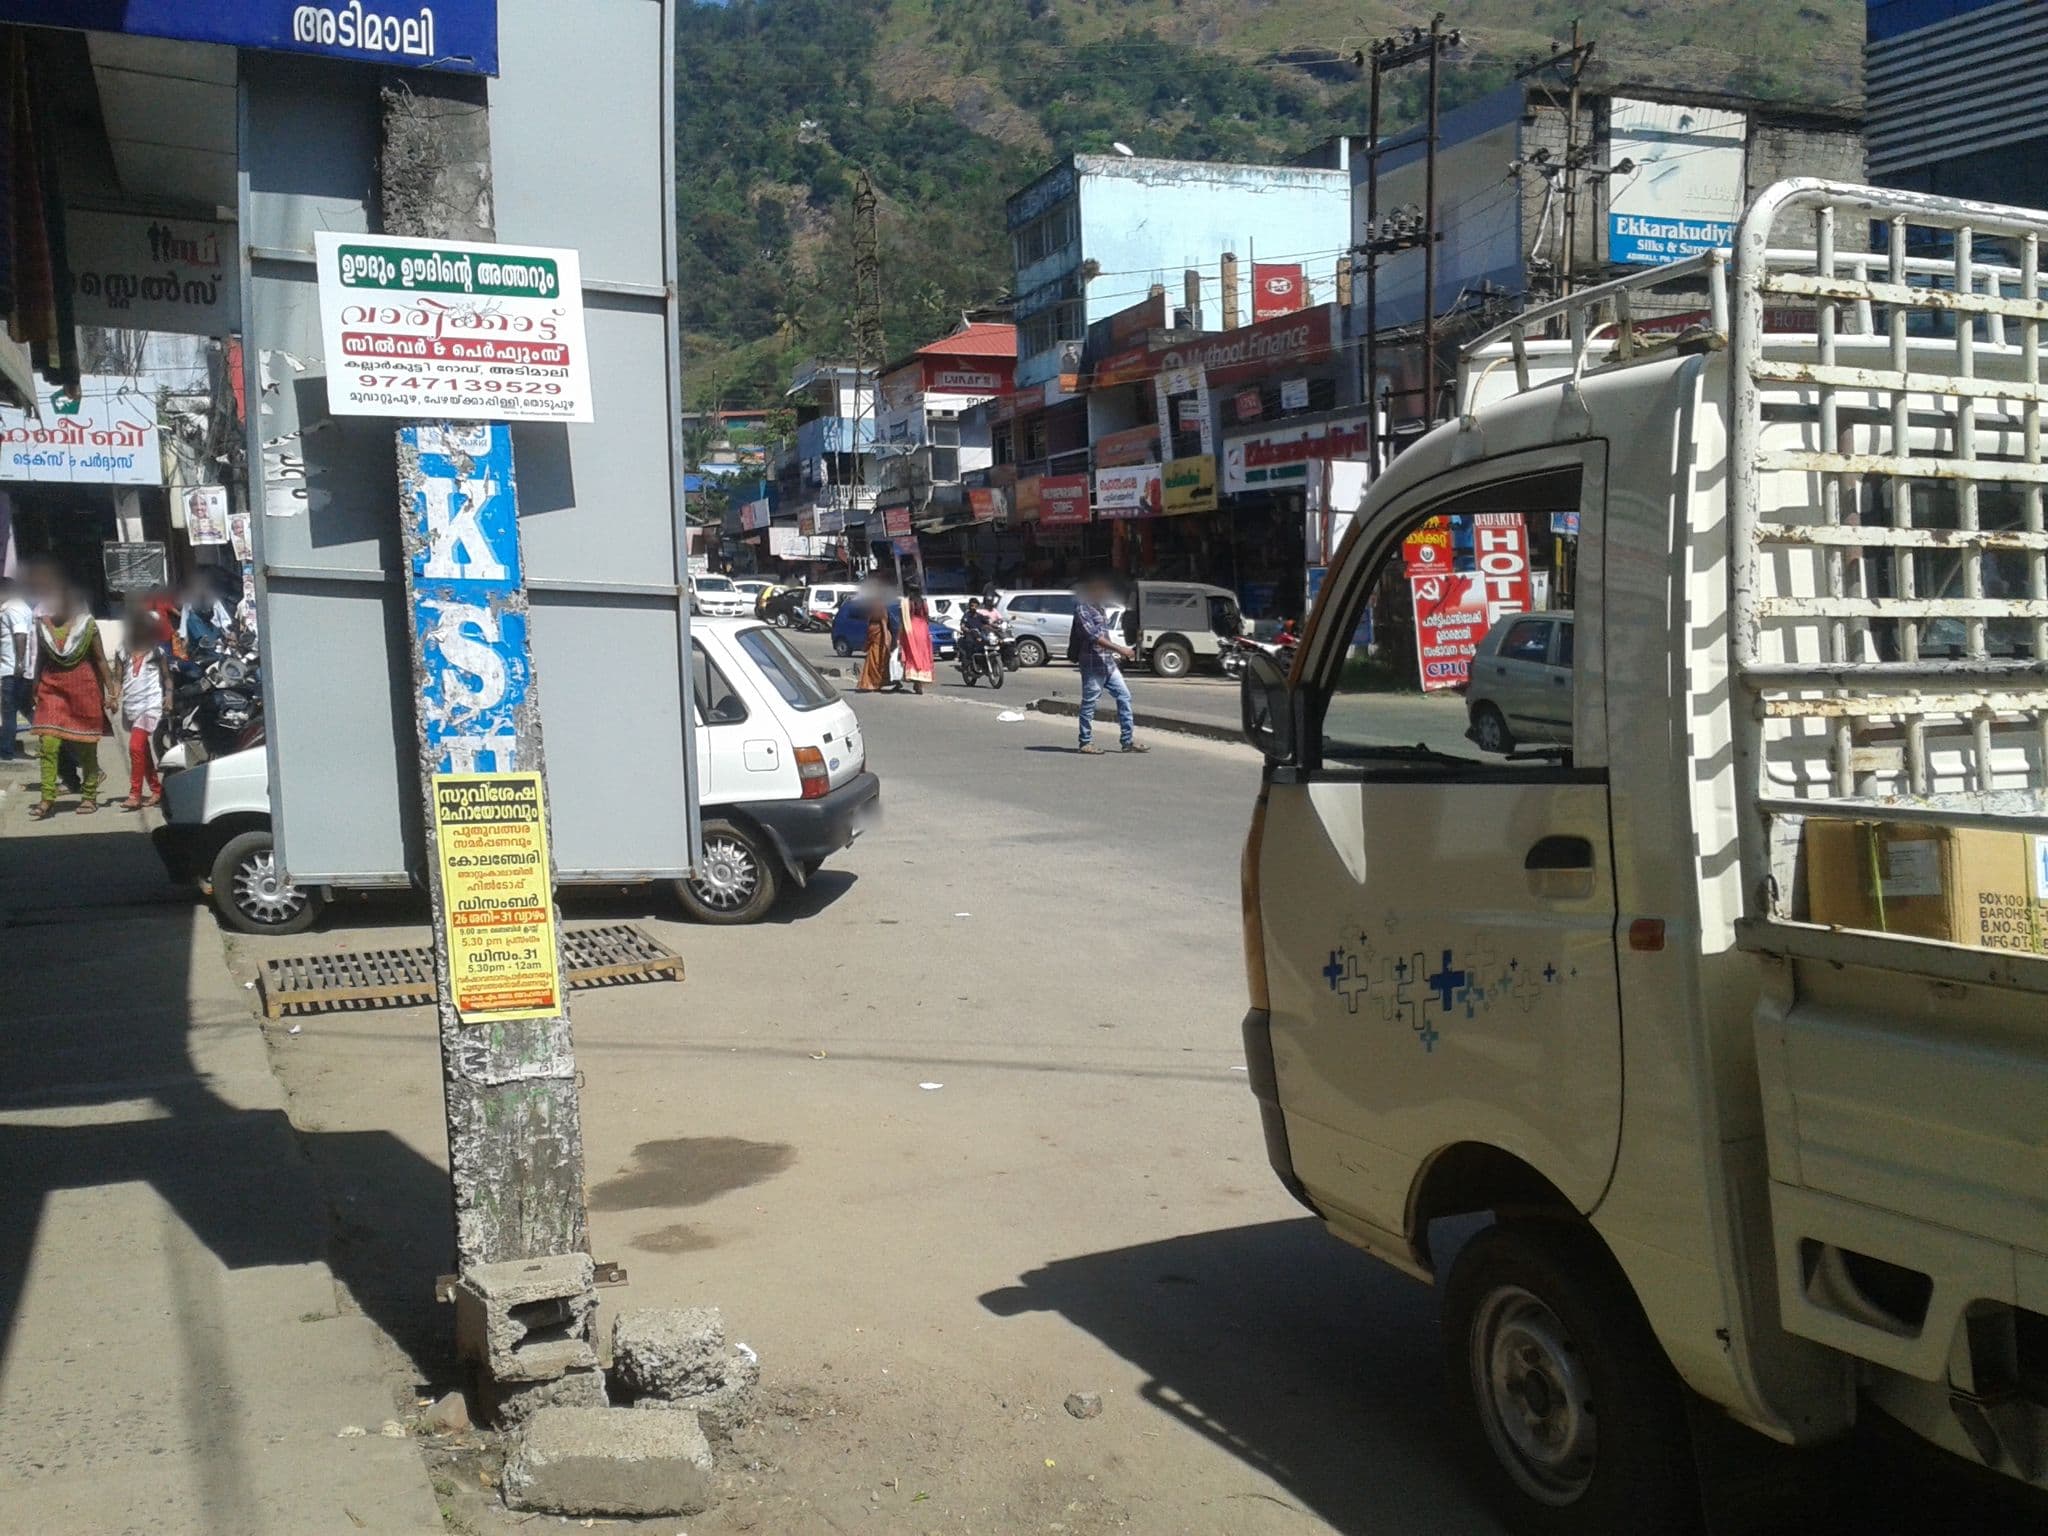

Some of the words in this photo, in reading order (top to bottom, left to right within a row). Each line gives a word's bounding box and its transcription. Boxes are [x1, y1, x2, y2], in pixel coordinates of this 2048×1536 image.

[293, 0, 434, 57] അടിമാലി
[1637, 240, 1664, 253] Silks
[1667, 242, 1677, 253] &
[1679, 243, 1713, 255] Sare
[341, 253, 396, 286] ഊദും
[477, 261, 555, 295] അത്തറും
[433, 343, 447, 355] &
[1249, 324, 1309, 356] Finance
[489, 365, 569, 378] അടിമാലി
[358, 374, 562, 395] 9747139529
[1479, 530, 1523, 625] HOTE
[439, 782, 537, 806] സുവിശേഷ
[458, 893, 539, 911] ഡിസംബർ
[462, 936, 483, 947] 5.30
[486, 937, 502, 946] pm
[523, 948, 538, 960] 31
[468, 963, 505, 974] 5.30pm
[515, 961, 542, 971] 12am
